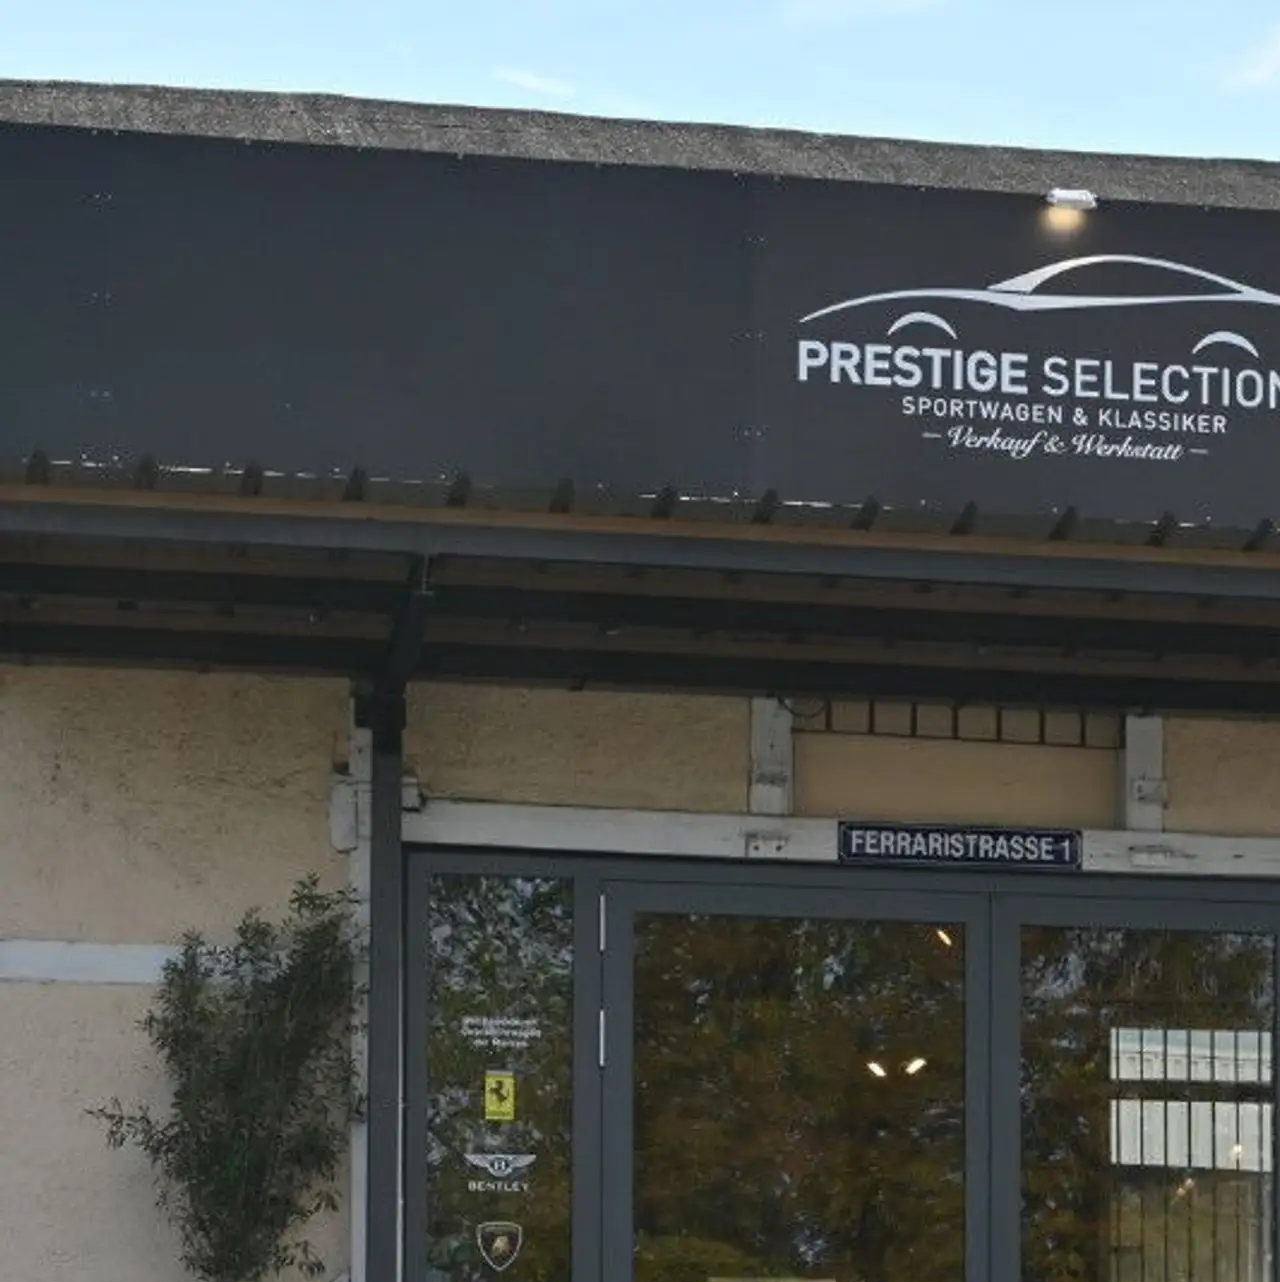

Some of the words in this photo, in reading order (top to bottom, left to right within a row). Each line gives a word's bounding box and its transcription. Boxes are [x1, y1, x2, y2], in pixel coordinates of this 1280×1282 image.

[798, 339, 1029, 395] PRESTIGE
[902, 395, 1063, 425] SPORTWAGEN
[1072, 406, 1089, 426] &
[1098, 408, 1228, 434] KLASSIKER
[947, 425, 1048, 460] Verkauf
[1043, 435, 1066, 454] &
[1071, 432, 1184, 461] Werkstatt
[851, 829, 1054, 861] FERRARISTRASSE
[1061, 838, 1071, 862] 1
[467, 1180, 530, 1192] BENTLEY
